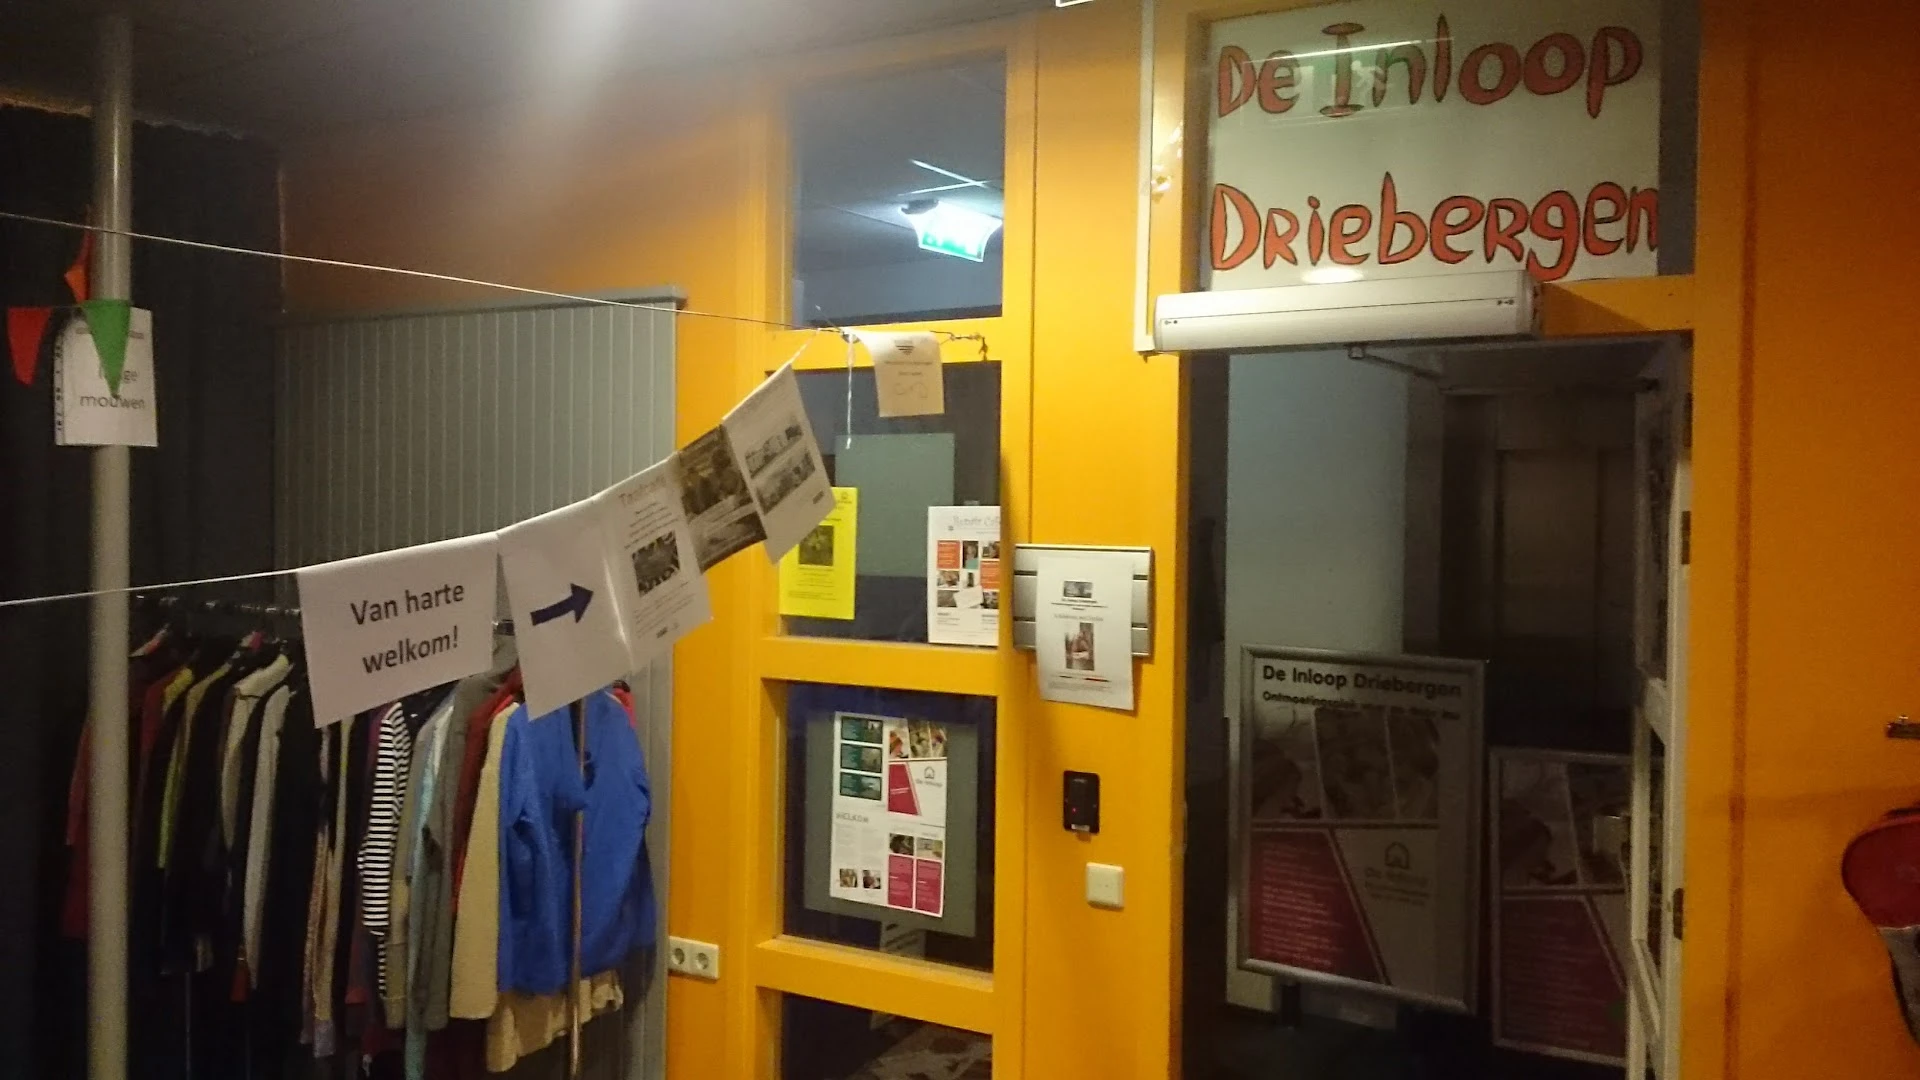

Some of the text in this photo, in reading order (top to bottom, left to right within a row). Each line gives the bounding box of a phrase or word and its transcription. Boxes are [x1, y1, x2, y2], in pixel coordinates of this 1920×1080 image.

[1217, 13, 1643, 119] De Inloop
[1210, 171, 1660, 282] Driebergen
[351, 584, 464, 625] Van harte
[362, 625, 459, 674] welkom!
[1262, 665, 1462, 700] De Inloop Driebergen
